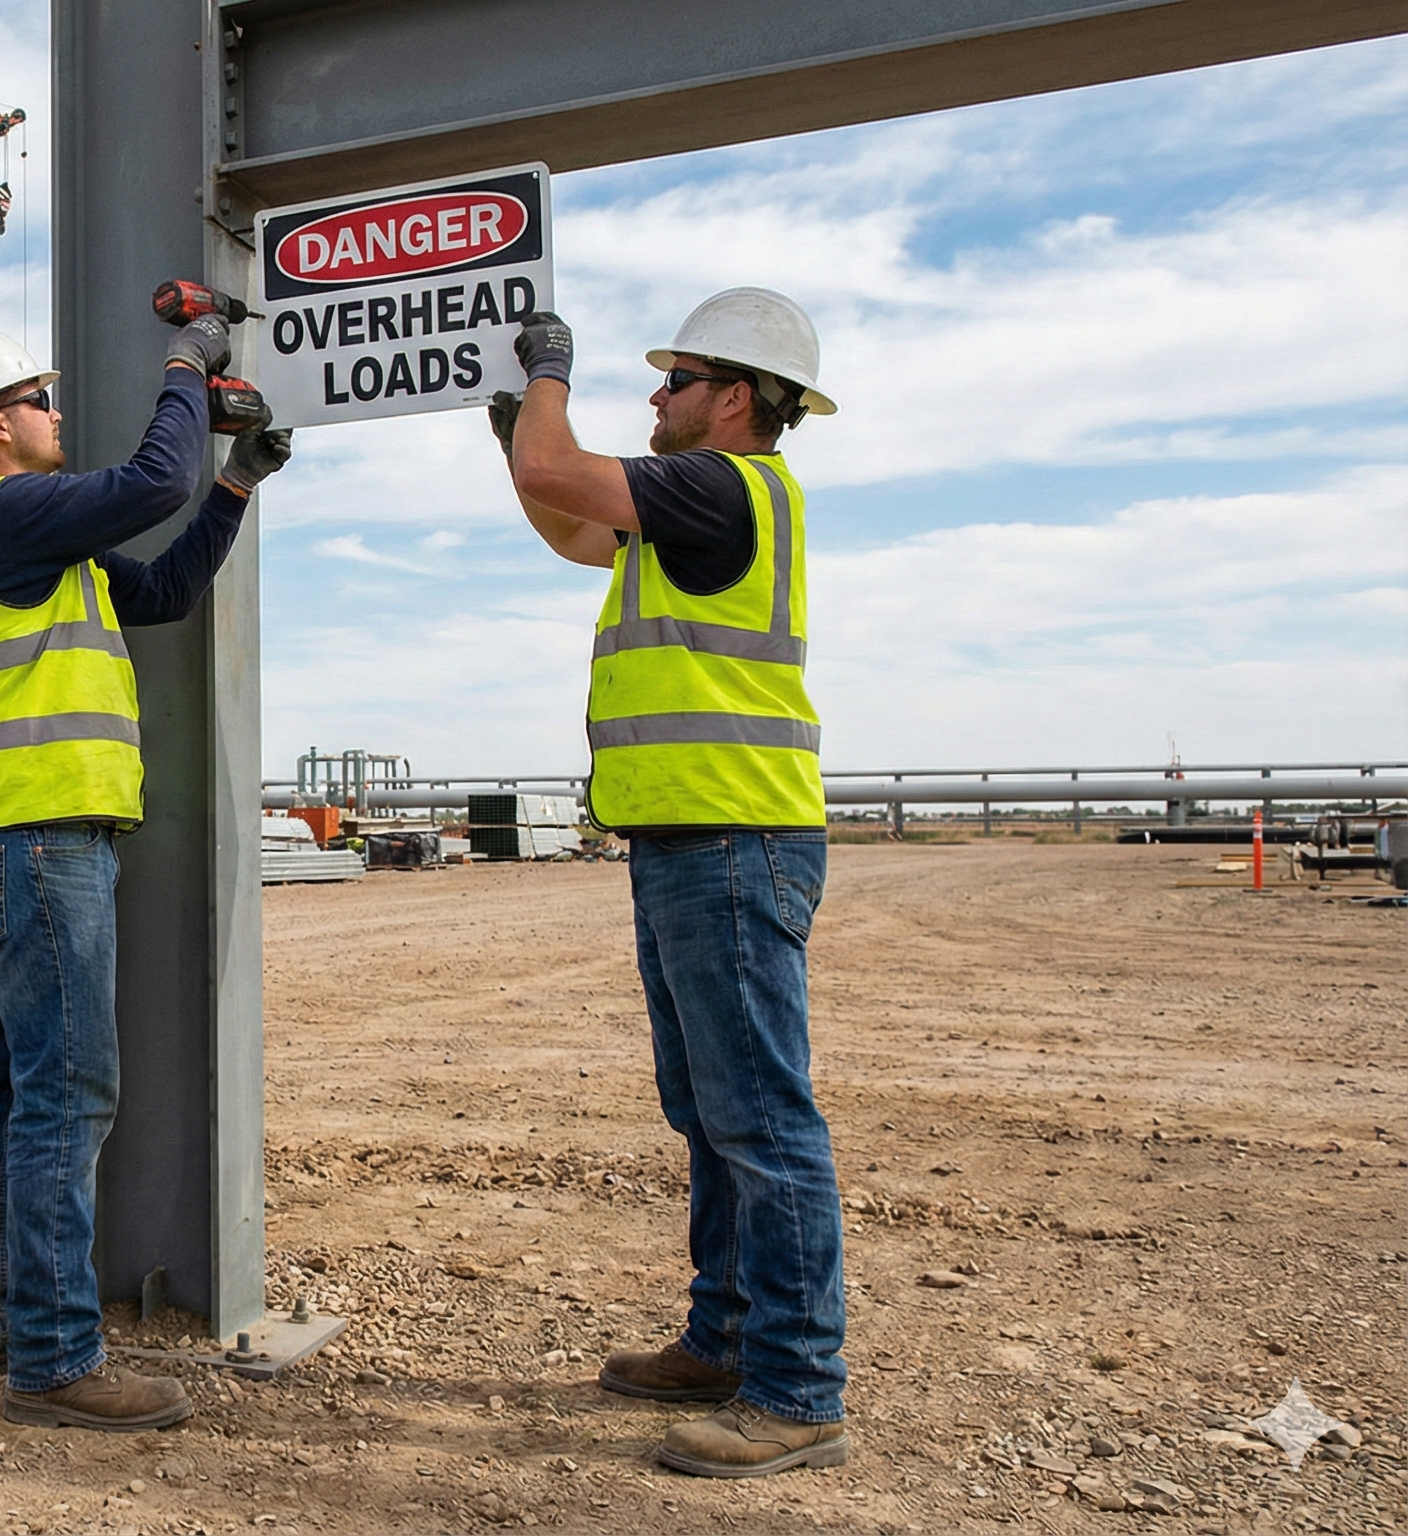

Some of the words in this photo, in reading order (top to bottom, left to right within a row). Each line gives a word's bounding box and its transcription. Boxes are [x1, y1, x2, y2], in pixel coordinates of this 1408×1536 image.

[298, 203, 503, 274] DANGER
[273, 276, 536, 355] OVERHEAD
[324, 342, 482, 406] LOADS
